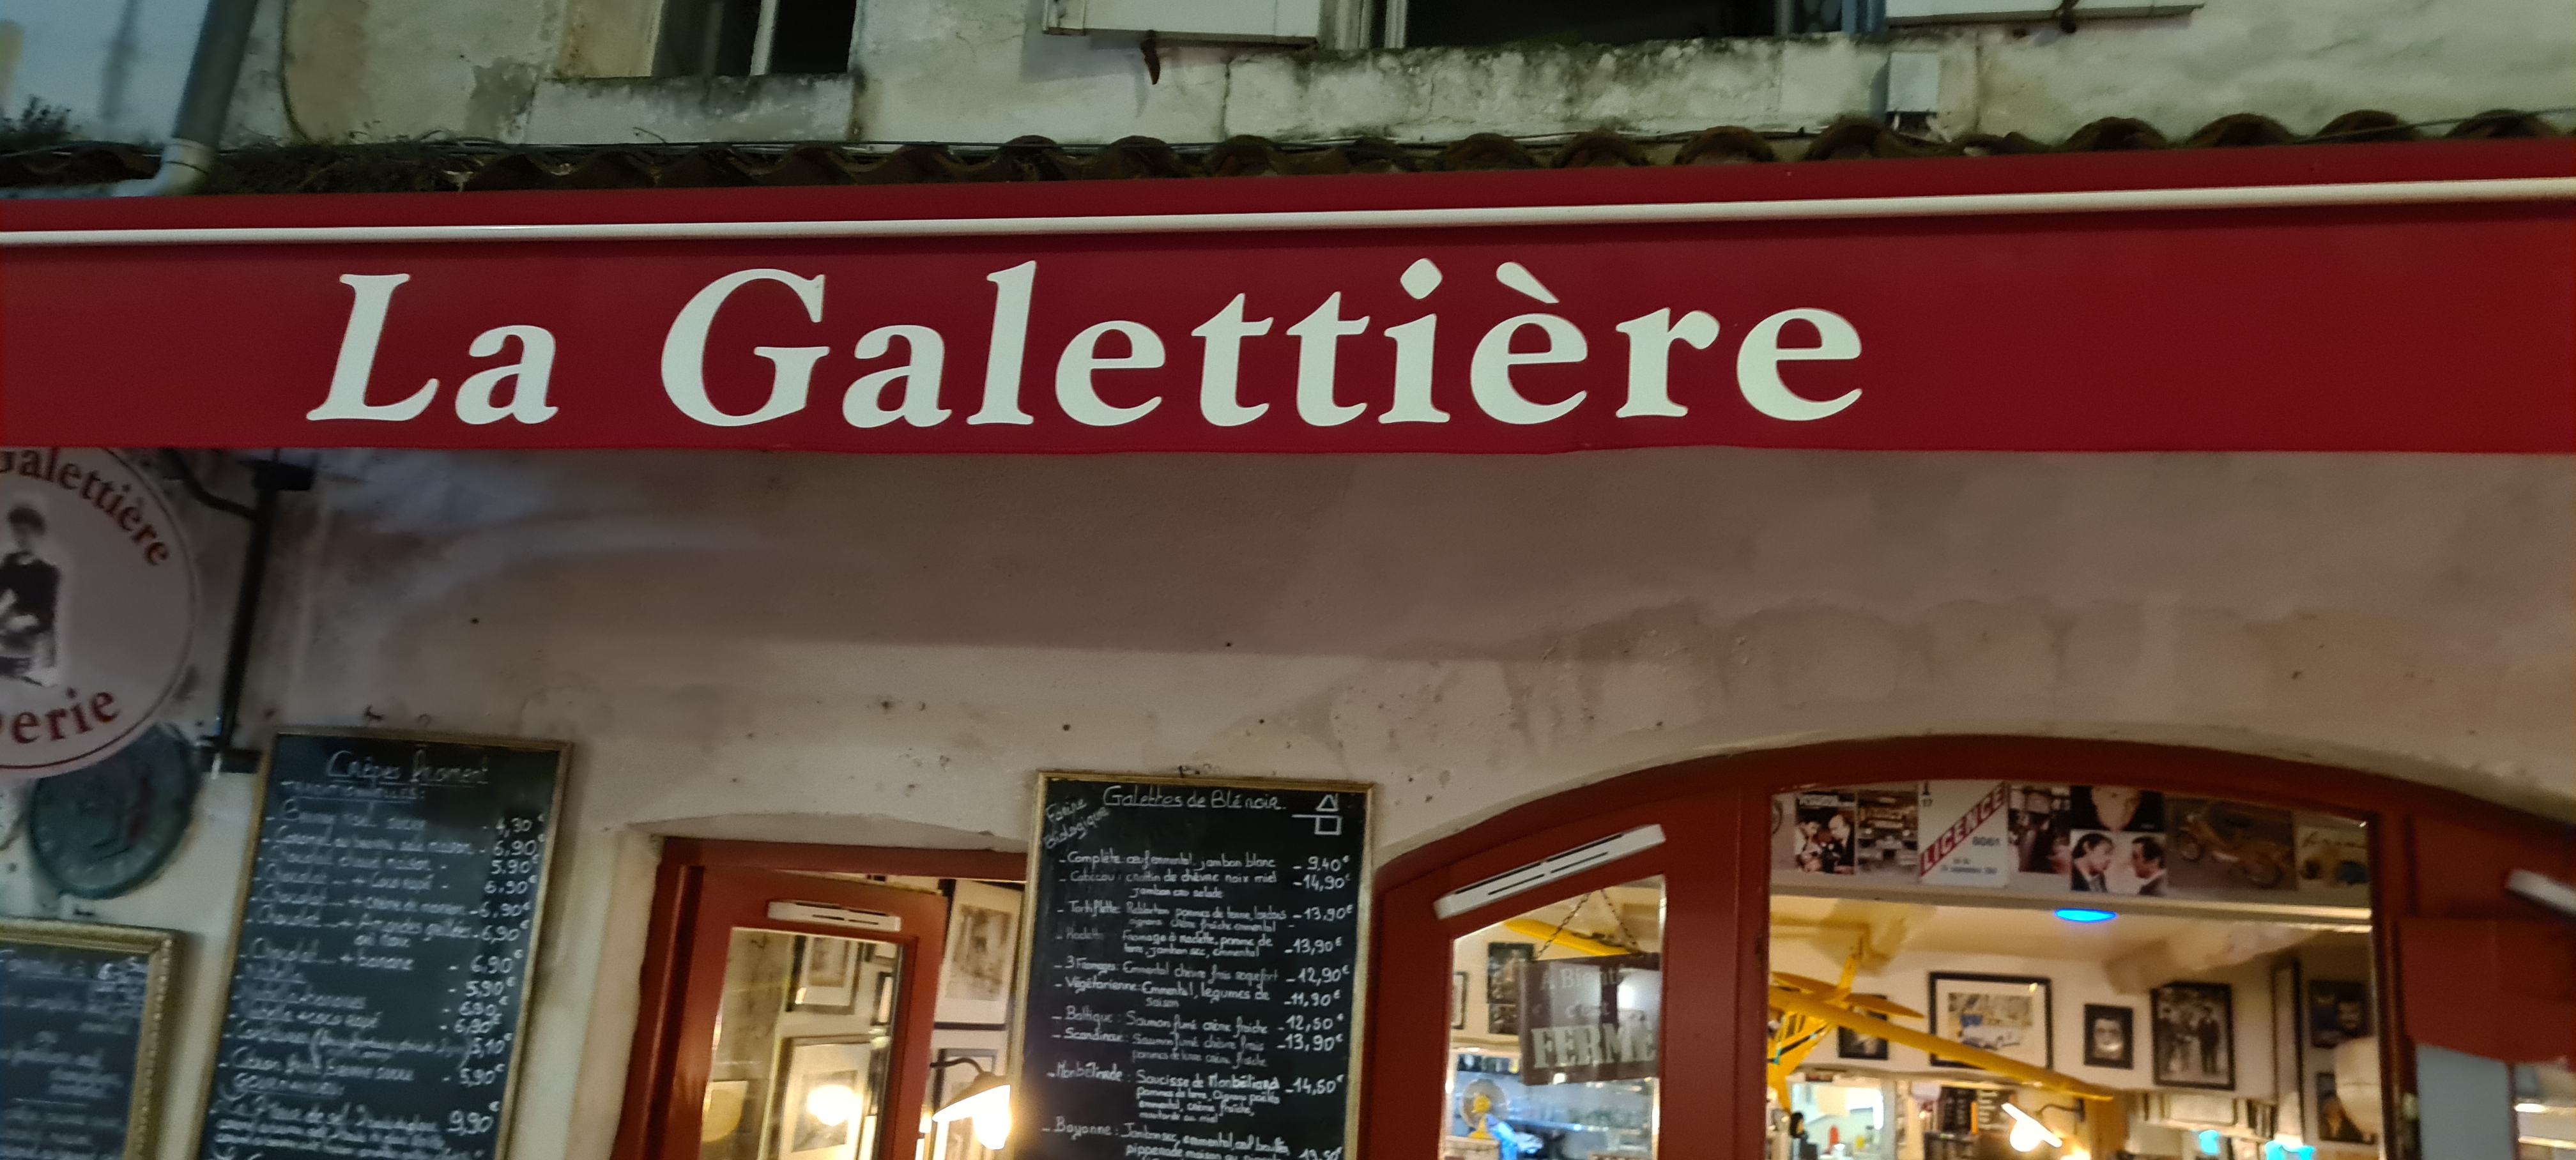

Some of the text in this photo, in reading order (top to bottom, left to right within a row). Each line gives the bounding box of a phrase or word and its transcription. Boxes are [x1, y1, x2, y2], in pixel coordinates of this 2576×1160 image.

[307, 259, 1862, 428] La Galettière
[0, 687, 120, 745] erie
[1103, 786, 1182, 807] Galettes
[1186, 791, 1208, 807] de
[1920, 782, 2006, 876] LICENCE
[1246, 851, 1276, 867] blanc
